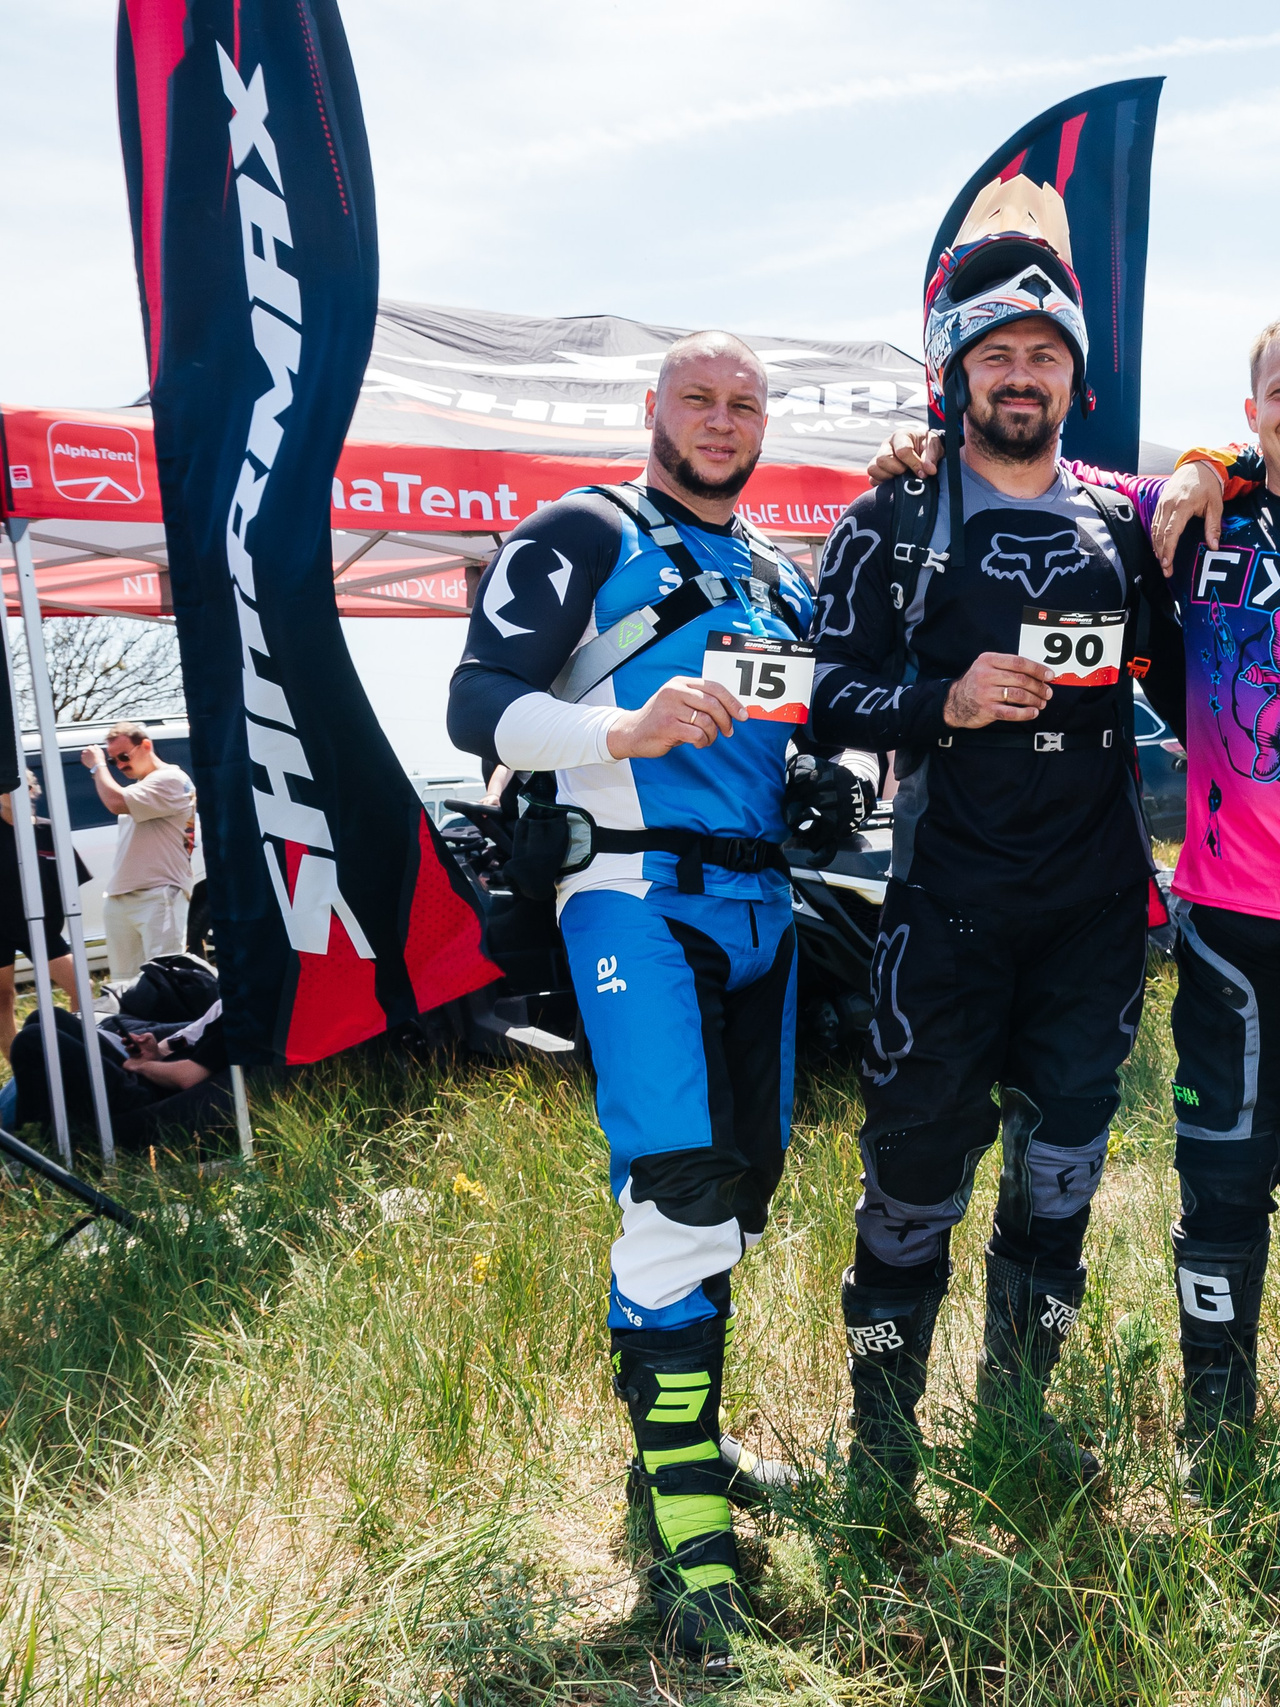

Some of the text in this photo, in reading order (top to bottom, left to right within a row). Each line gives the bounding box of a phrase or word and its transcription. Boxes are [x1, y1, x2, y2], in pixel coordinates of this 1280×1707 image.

[54, 443, 135, 463] AlphaTent
[215, 40, 376, 960] SHARMAX
[1043, 632, 1104, 668] 90
[735, 659, 786, 700] 15
[828, 681, 914, 715] FOX
